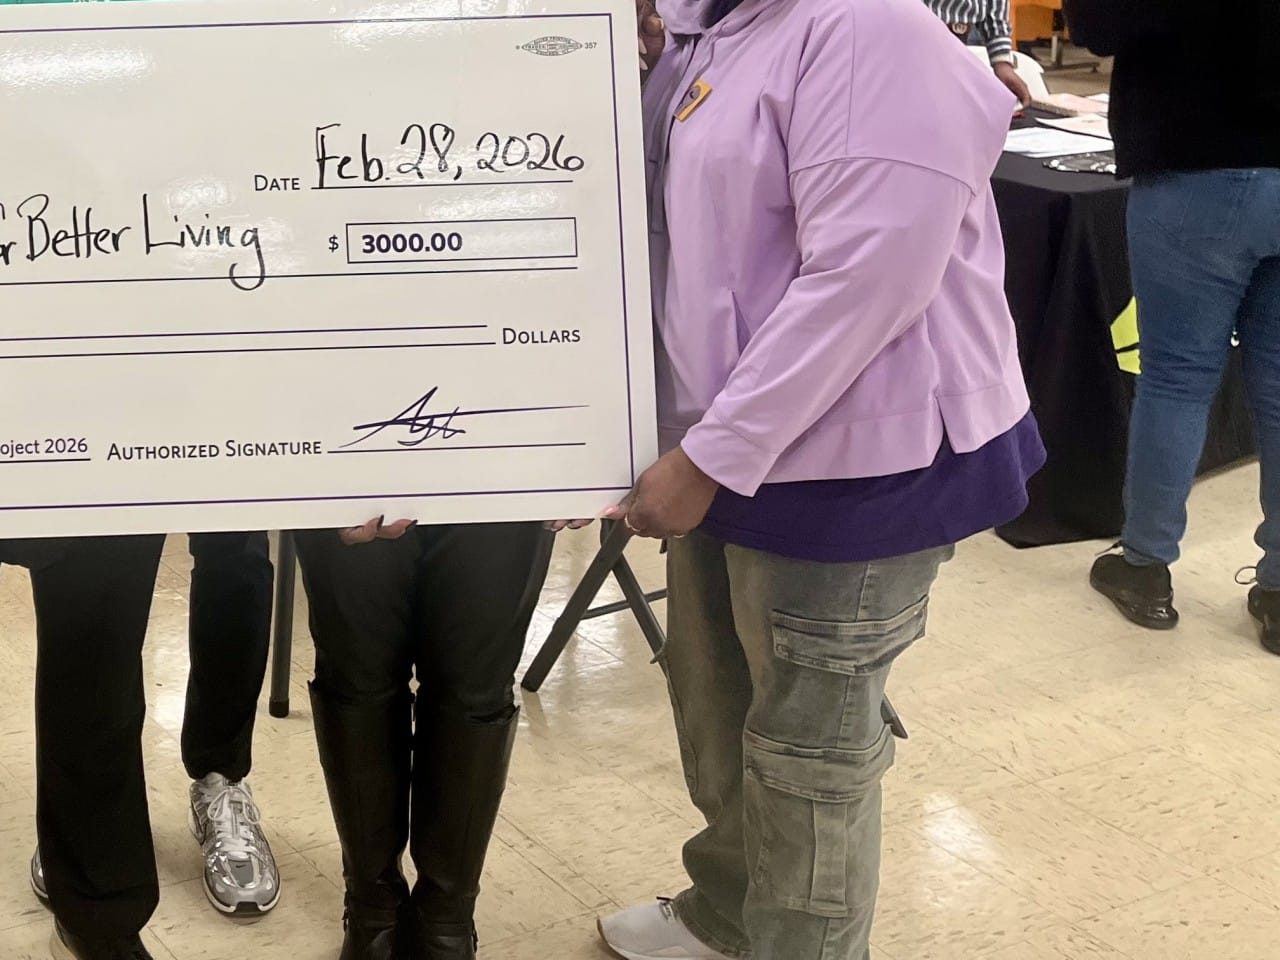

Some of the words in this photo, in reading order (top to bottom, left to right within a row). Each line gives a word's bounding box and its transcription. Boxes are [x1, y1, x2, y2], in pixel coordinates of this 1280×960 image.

[475, 132, 585, 173] 2026
[15, 193, 132, 261] Better
[143, 193, 266, 291] Living
[361, 232, 463, 254] 3000.00
[44, 438, 88, 454] 2026
